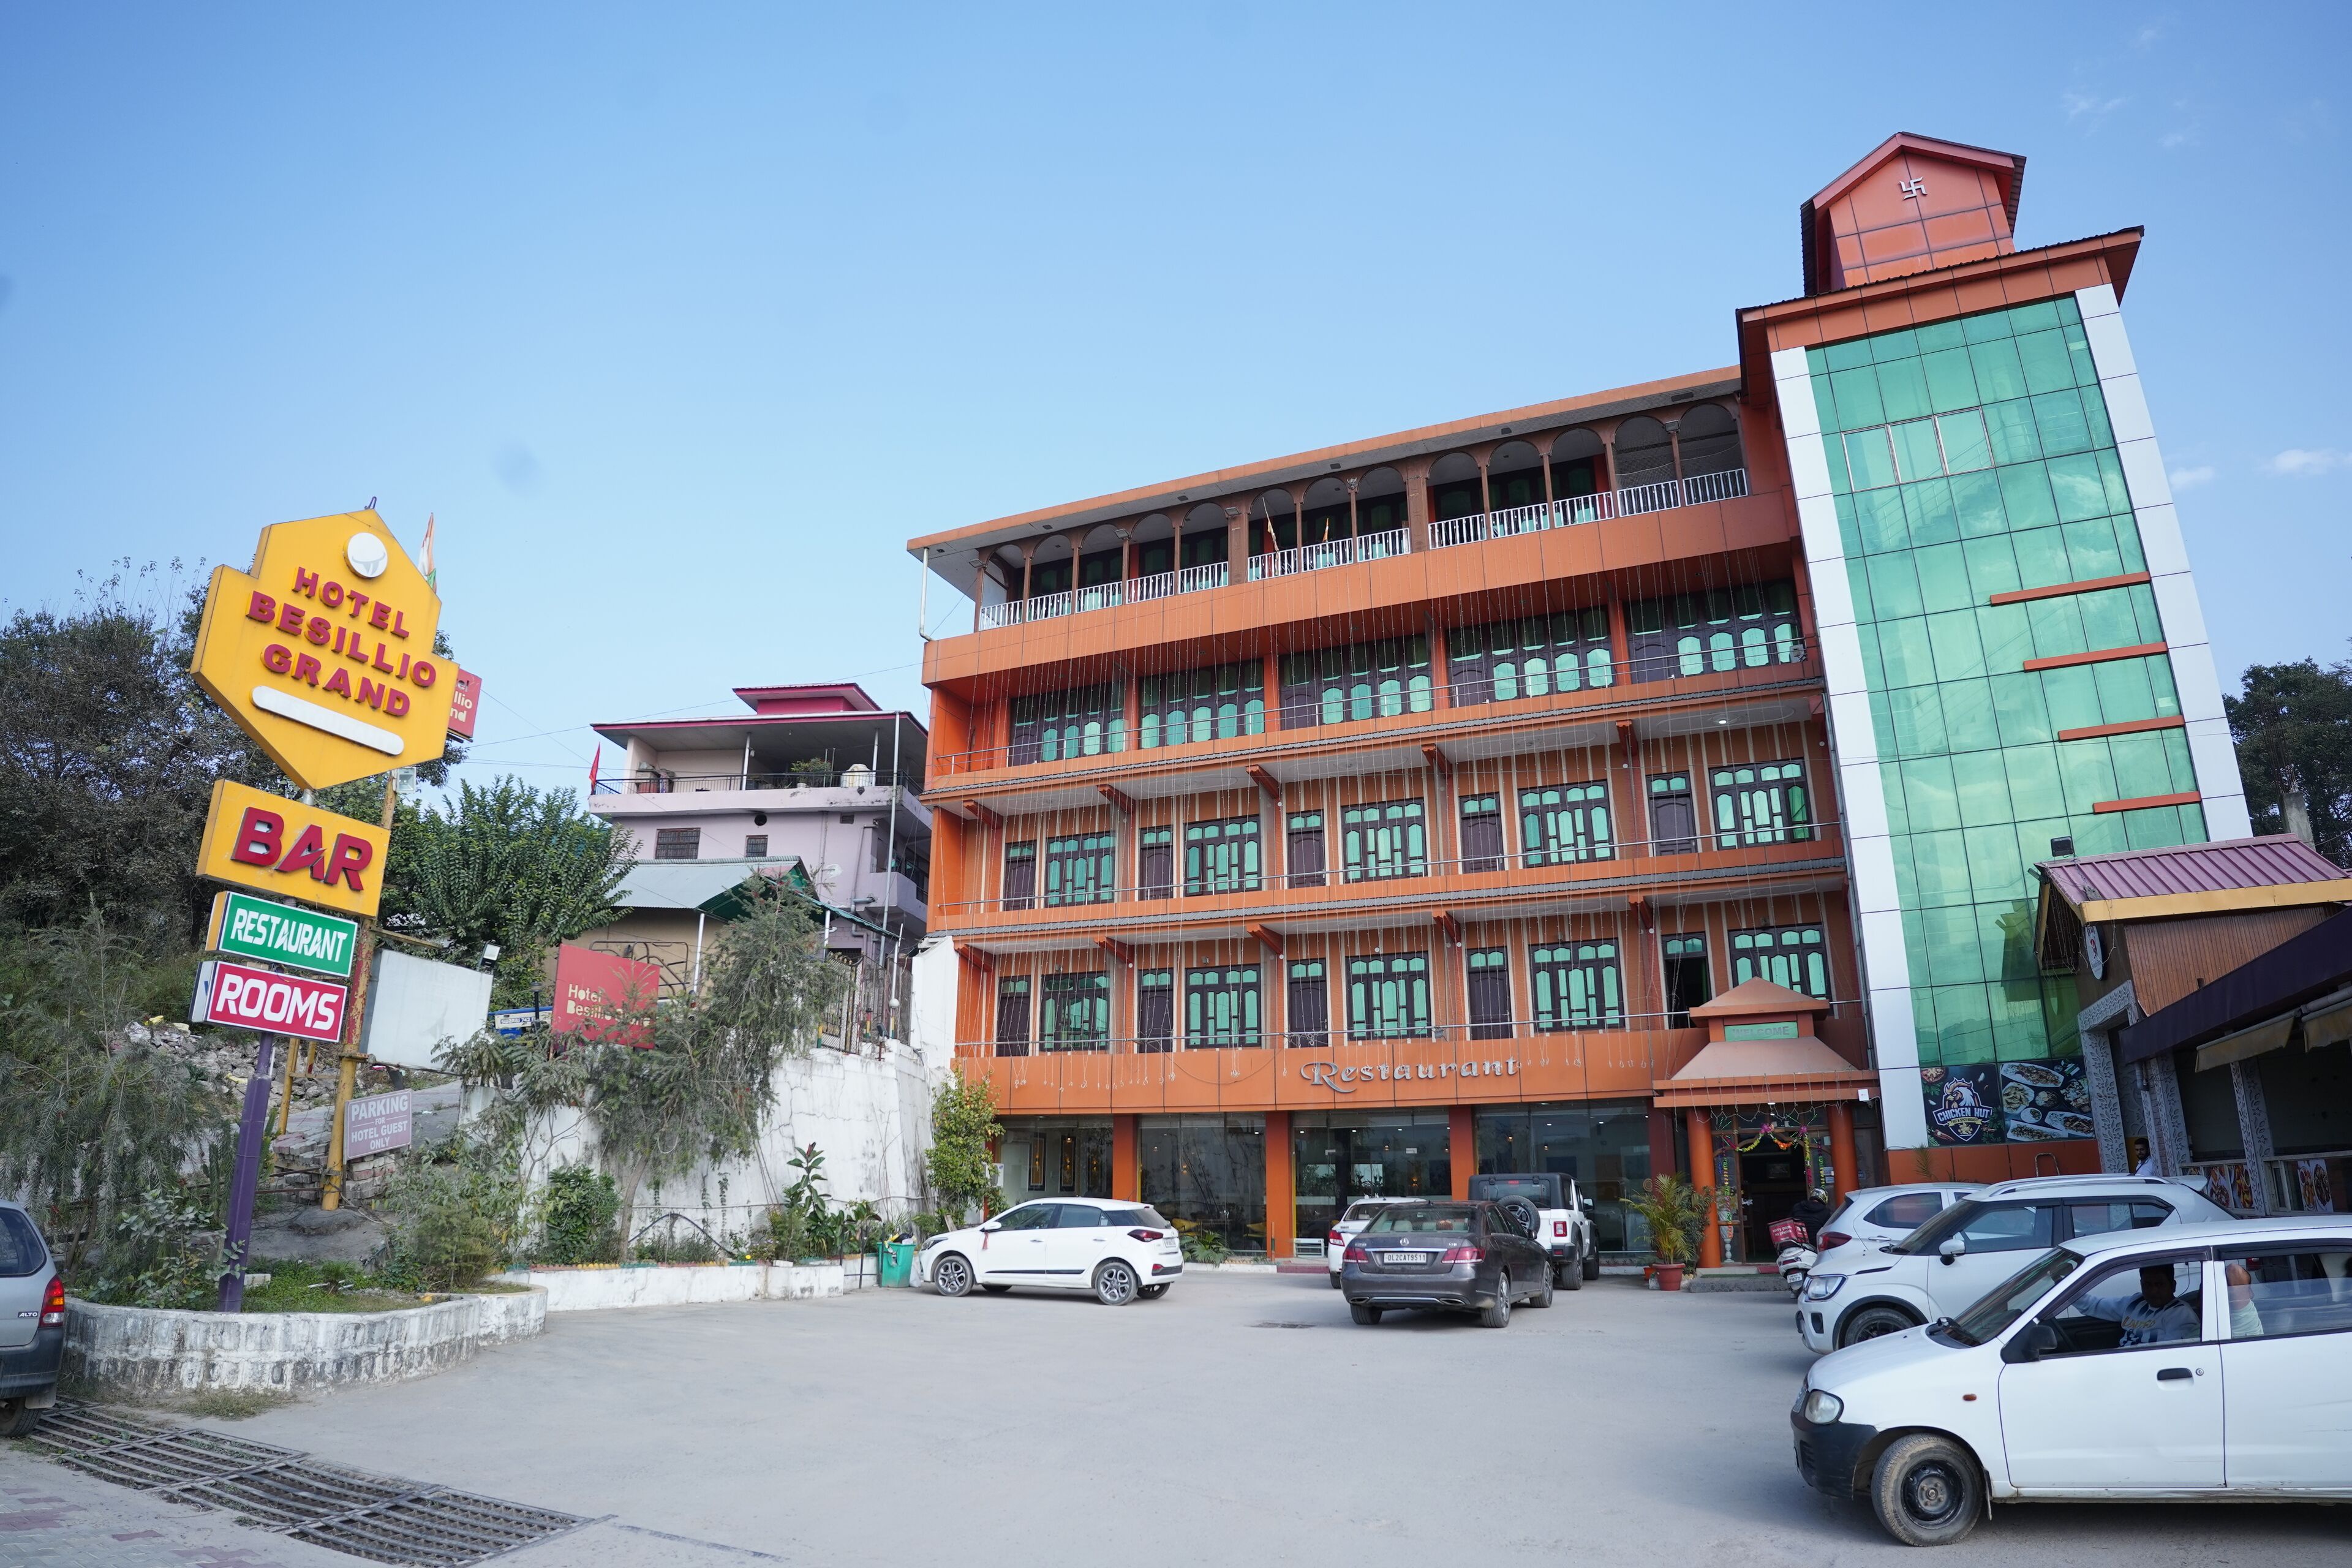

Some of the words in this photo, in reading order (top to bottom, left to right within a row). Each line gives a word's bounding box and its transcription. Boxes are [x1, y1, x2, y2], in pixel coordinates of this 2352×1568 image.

[292, 567, 409, 639] HOTEL
[246, 590, 436, 687] BESILLIO
[260, 644, 410, 716] GRAND
[230, 807, 372, 891] BAR
[230, 908, 348, 962] RESTAURANT
[216, 973, 339, 1030] ROOMS
[1732, 1026, 1790, 1036] WELCOME
[1300, 1056, 1518, 1093] Restaurant
[351, 1095, 408, 1121] PARKING
[375, 1117, 385, 1125] FOR
[1937, 1107, 1971, 1121] CHICKEN
[1974, 1108, 1990, 1118] HUT
[351, 1128, 379, 1143] HOTEL
[381, 1121, 408, 1136] GUEST
[370, 1137, 390, 1150] ONLY
